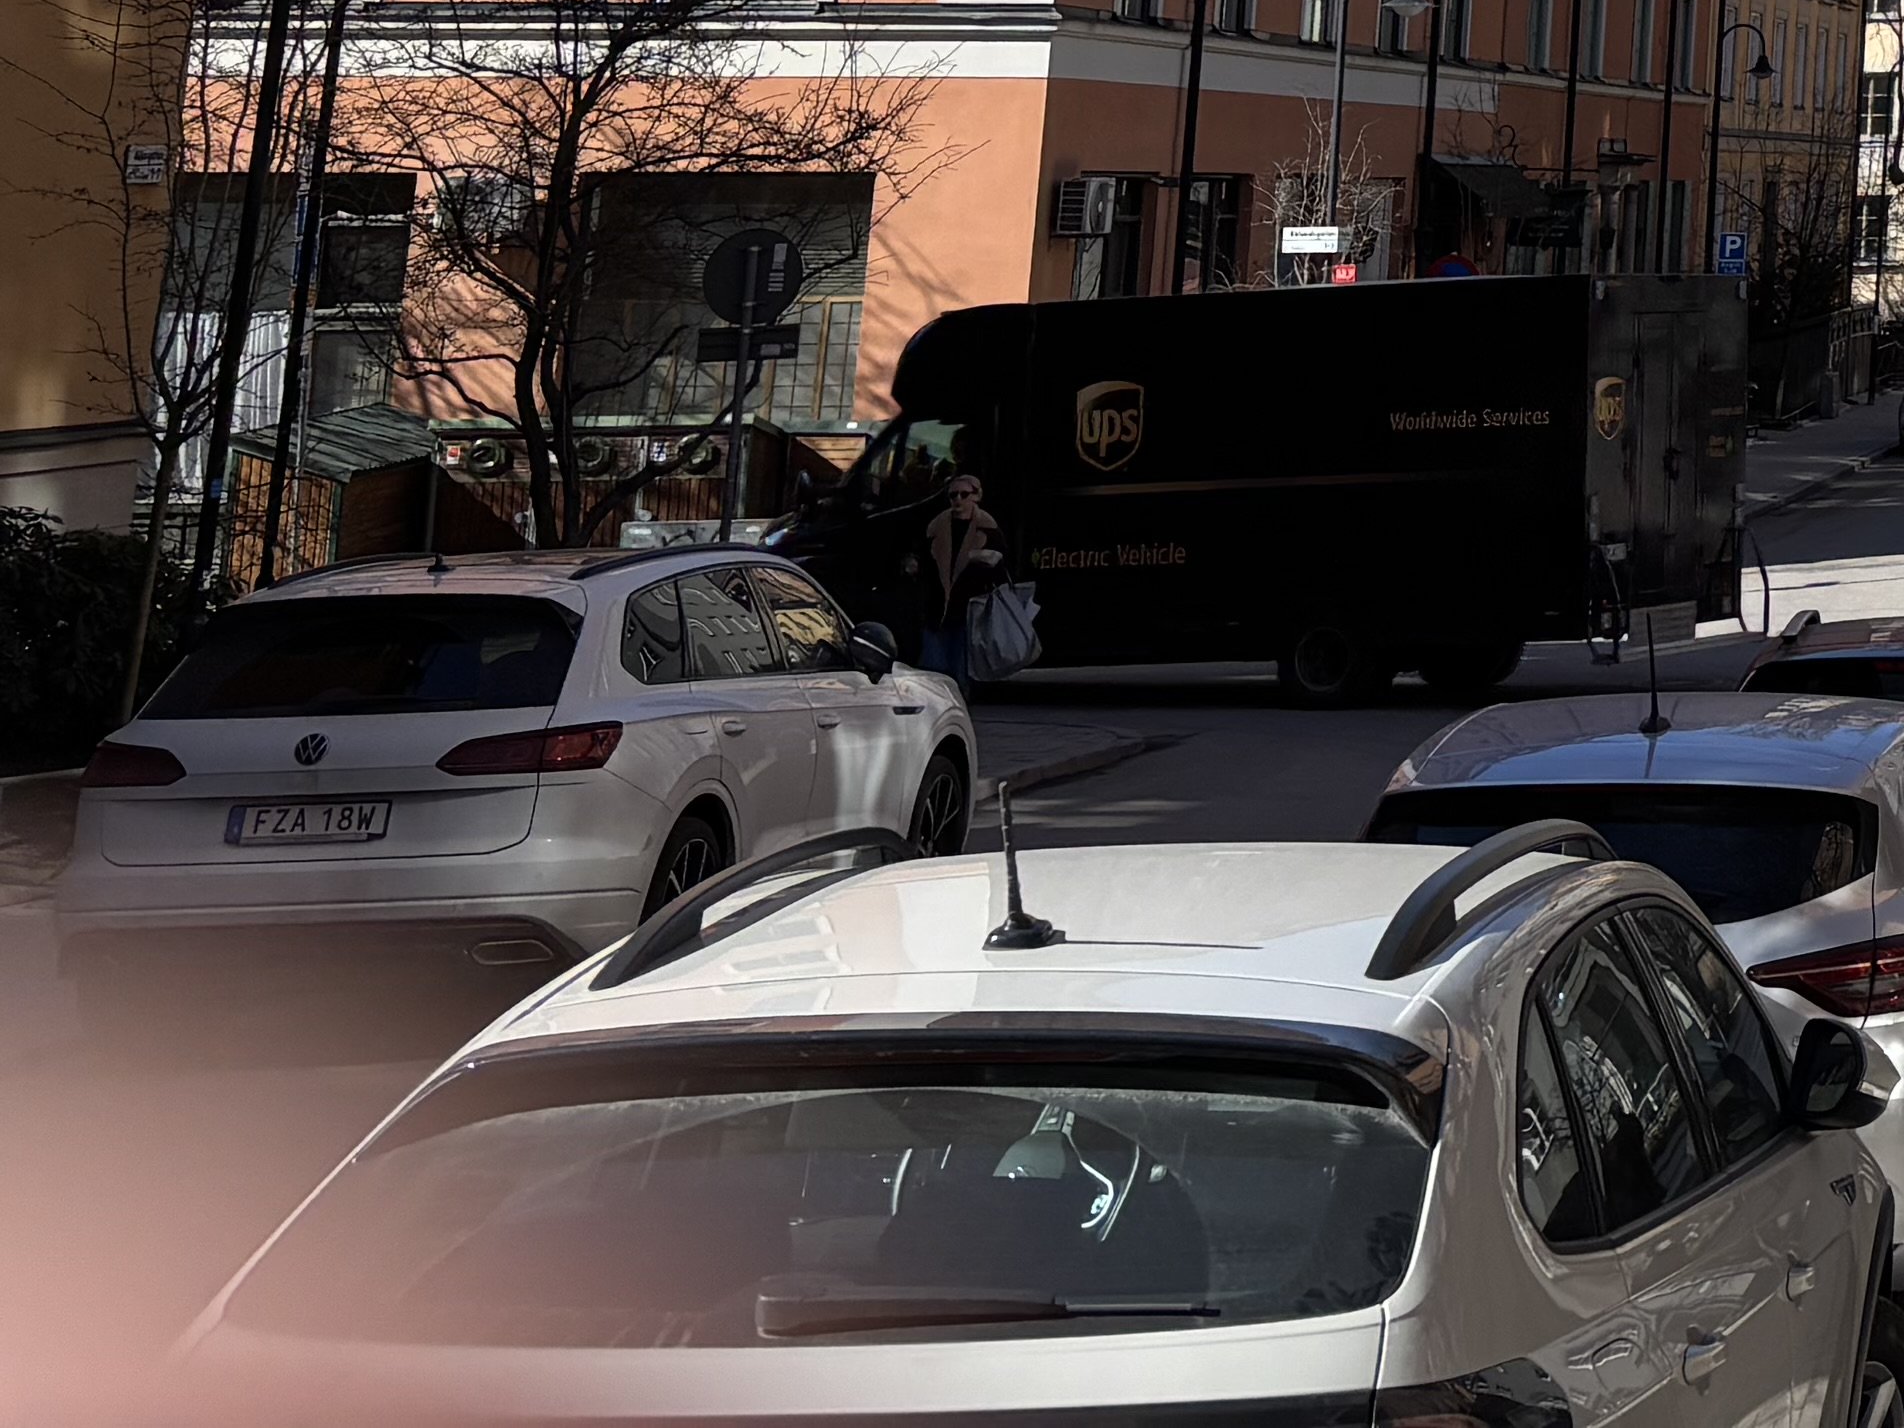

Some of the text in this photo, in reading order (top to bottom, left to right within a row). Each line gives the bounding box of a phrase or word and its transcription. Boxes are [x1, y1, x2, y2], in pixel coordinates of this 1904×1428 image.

[1725, 235, 1742, 257] P
[1483, 407, 1550, 427] Services
[253, 805, 377, 834] FZA 18W
